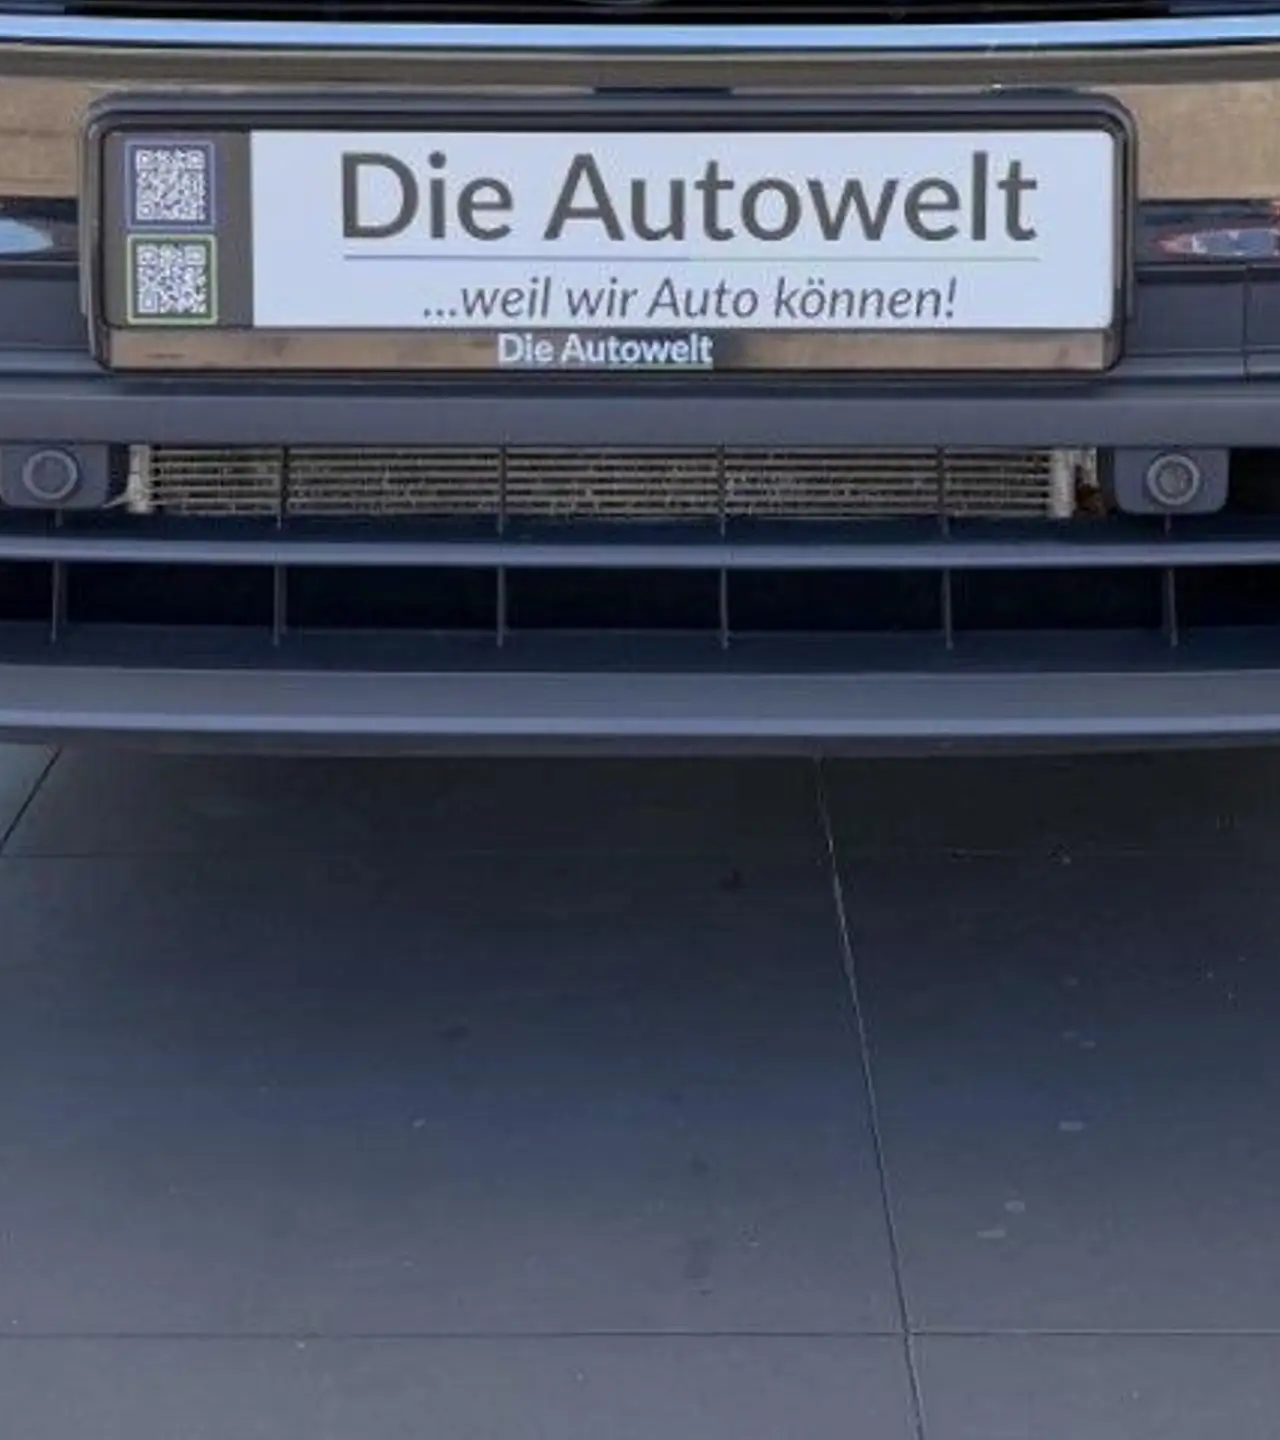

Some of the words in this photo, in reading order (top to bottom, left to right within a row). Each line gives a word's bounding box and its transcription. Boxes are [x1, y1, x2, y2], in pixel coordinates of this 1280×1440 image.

[342, 151, 513, 241] Die
[544, 151, 1037, 241] Autowelt
[423, 276, 551, 318] ...weil
[566, 276, 639, 318] wir
[647, 276, 759, 319] Auto
[774, 276, 957, 319] können!
[497, 333, 554, 364] Die
[561, 333, 713, 364] Autowelt
